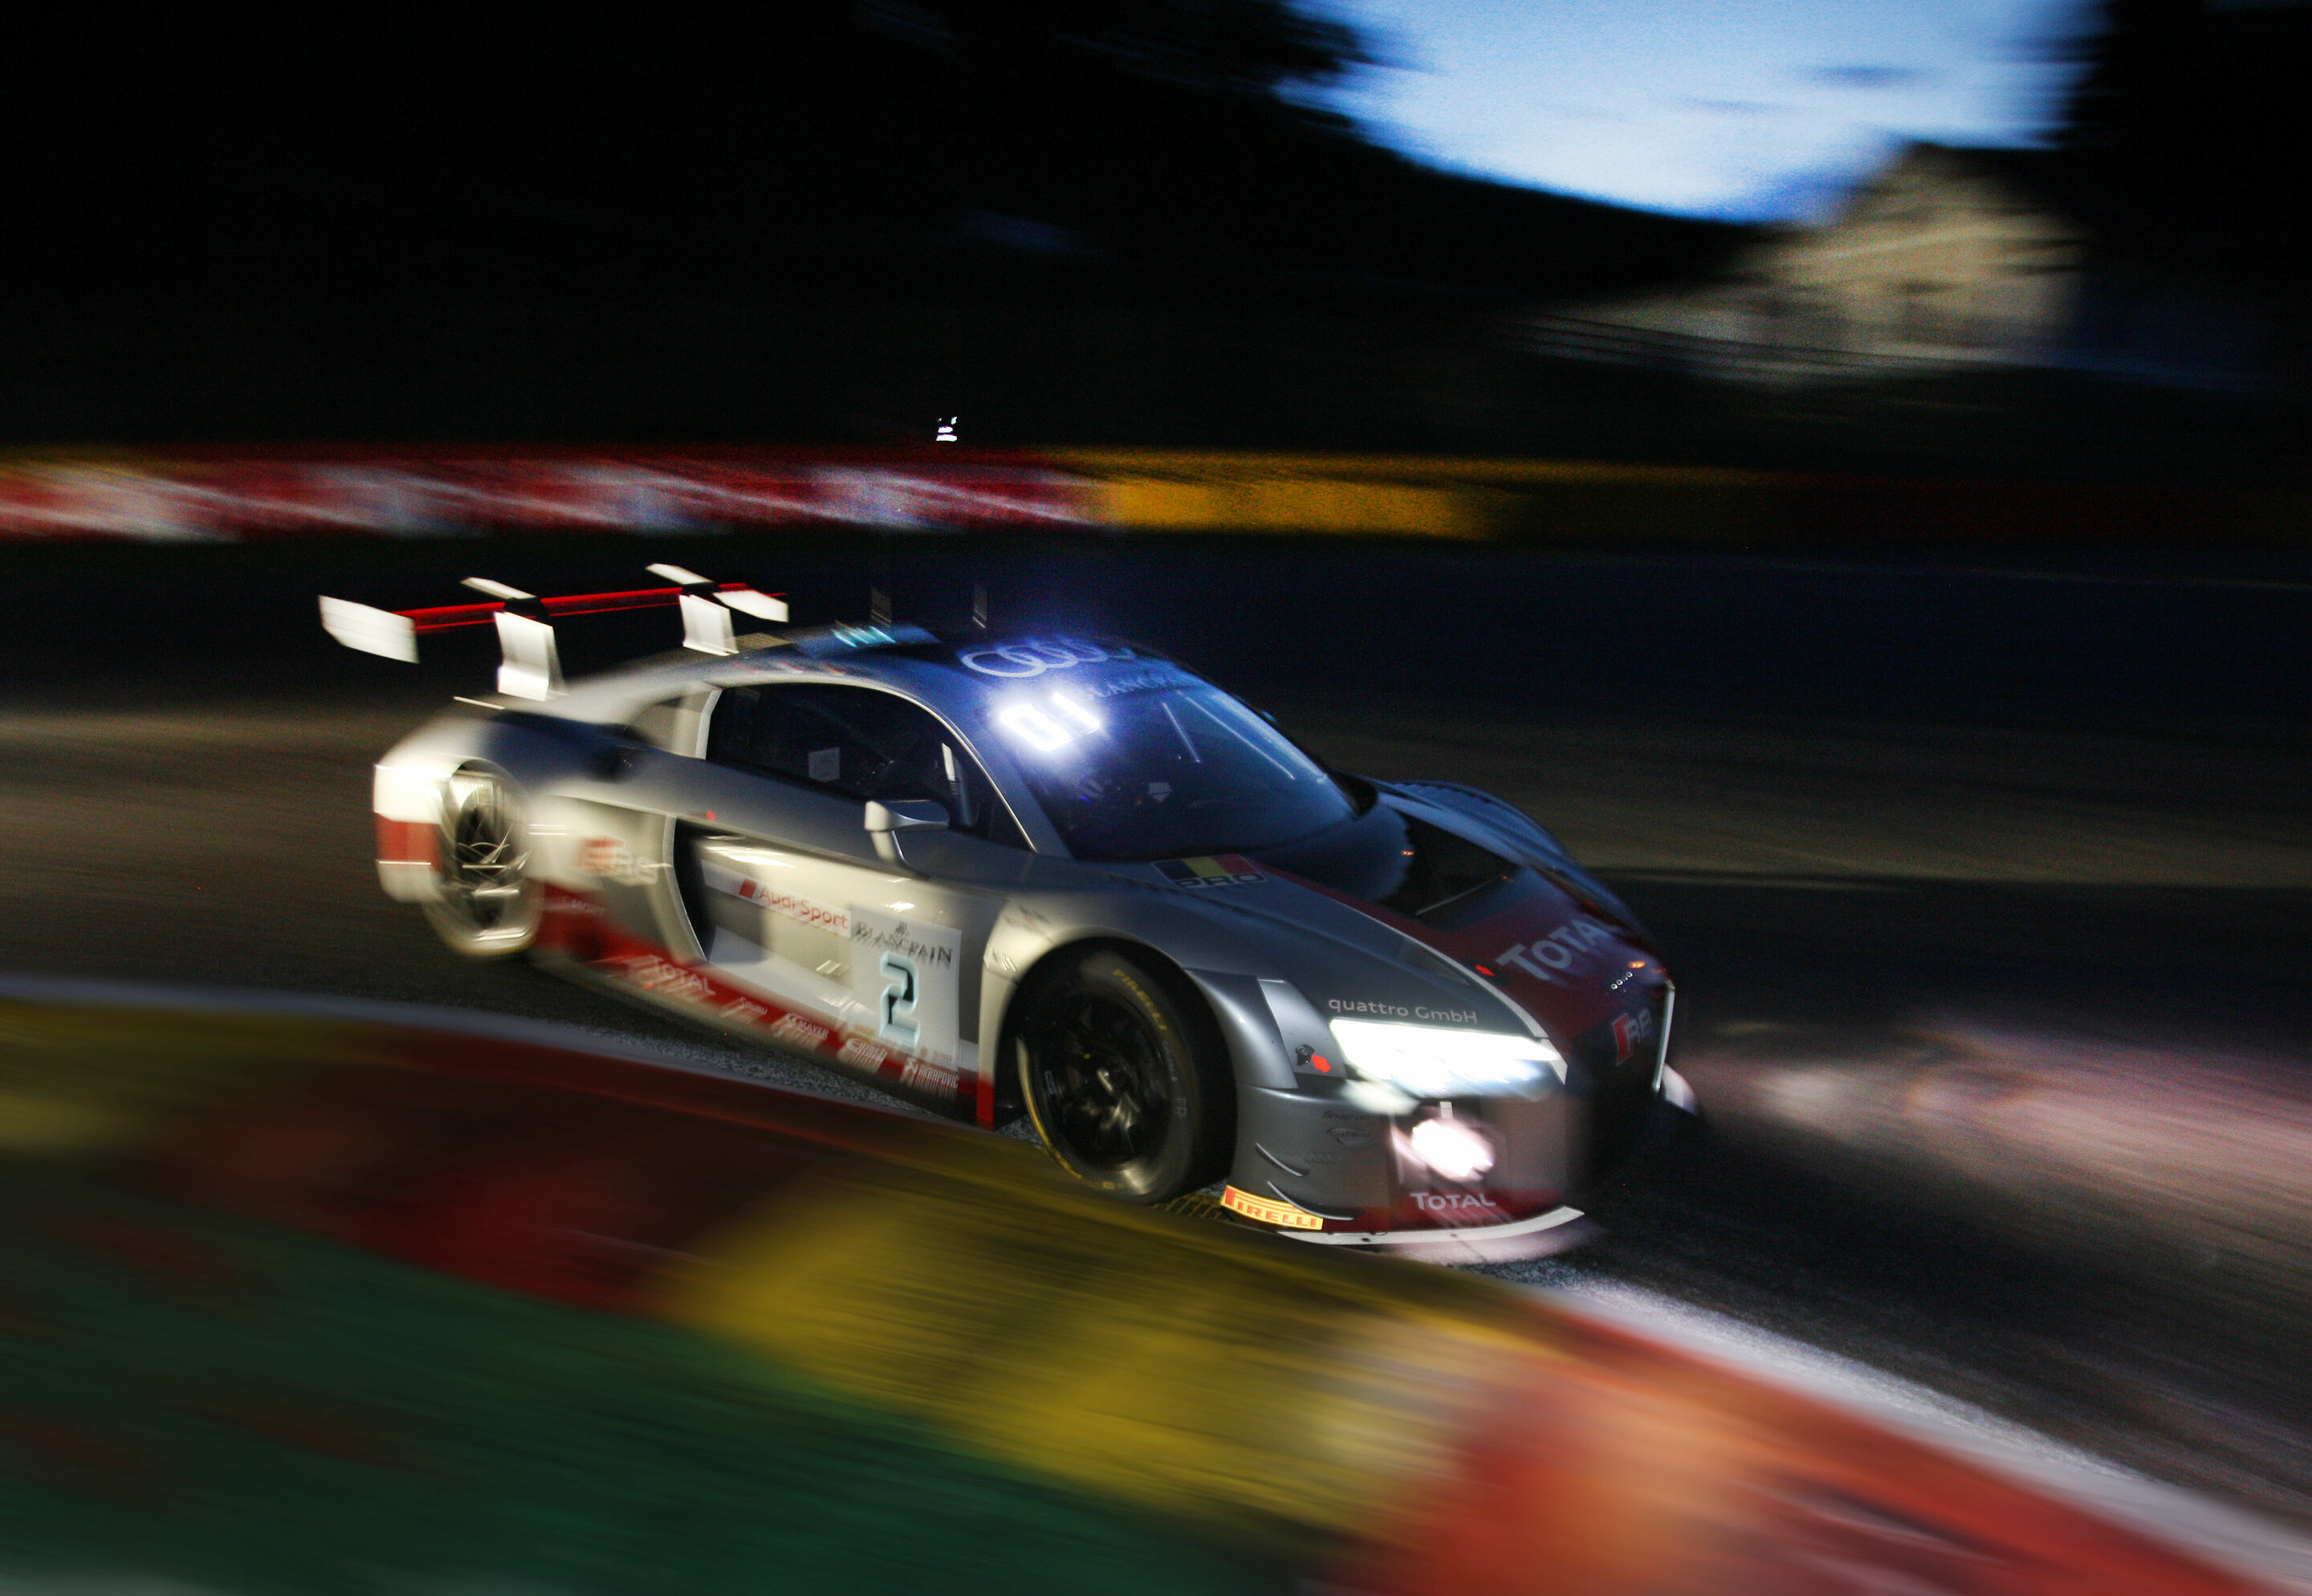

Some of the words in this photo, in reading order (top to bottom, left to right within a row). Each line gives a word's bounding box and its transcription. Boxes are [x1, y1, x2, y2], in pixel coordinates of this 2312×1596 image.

[759, 886, 796, 910] Audi
[801, 898, 849, 929] Sport
[856, 922, 954, 966] BLANCPAIN
[649, 953, 716, 995] TOTAL
[879, 951, 921, 1047] 2
[1329, 999, 1409, 1017] quattro
[1415, 1006, 1478, 1024] GmbH
[1224, 1187, 1318, 1228] PIRELLI
[1410, 1192, 1496, 1211] TOTAL
